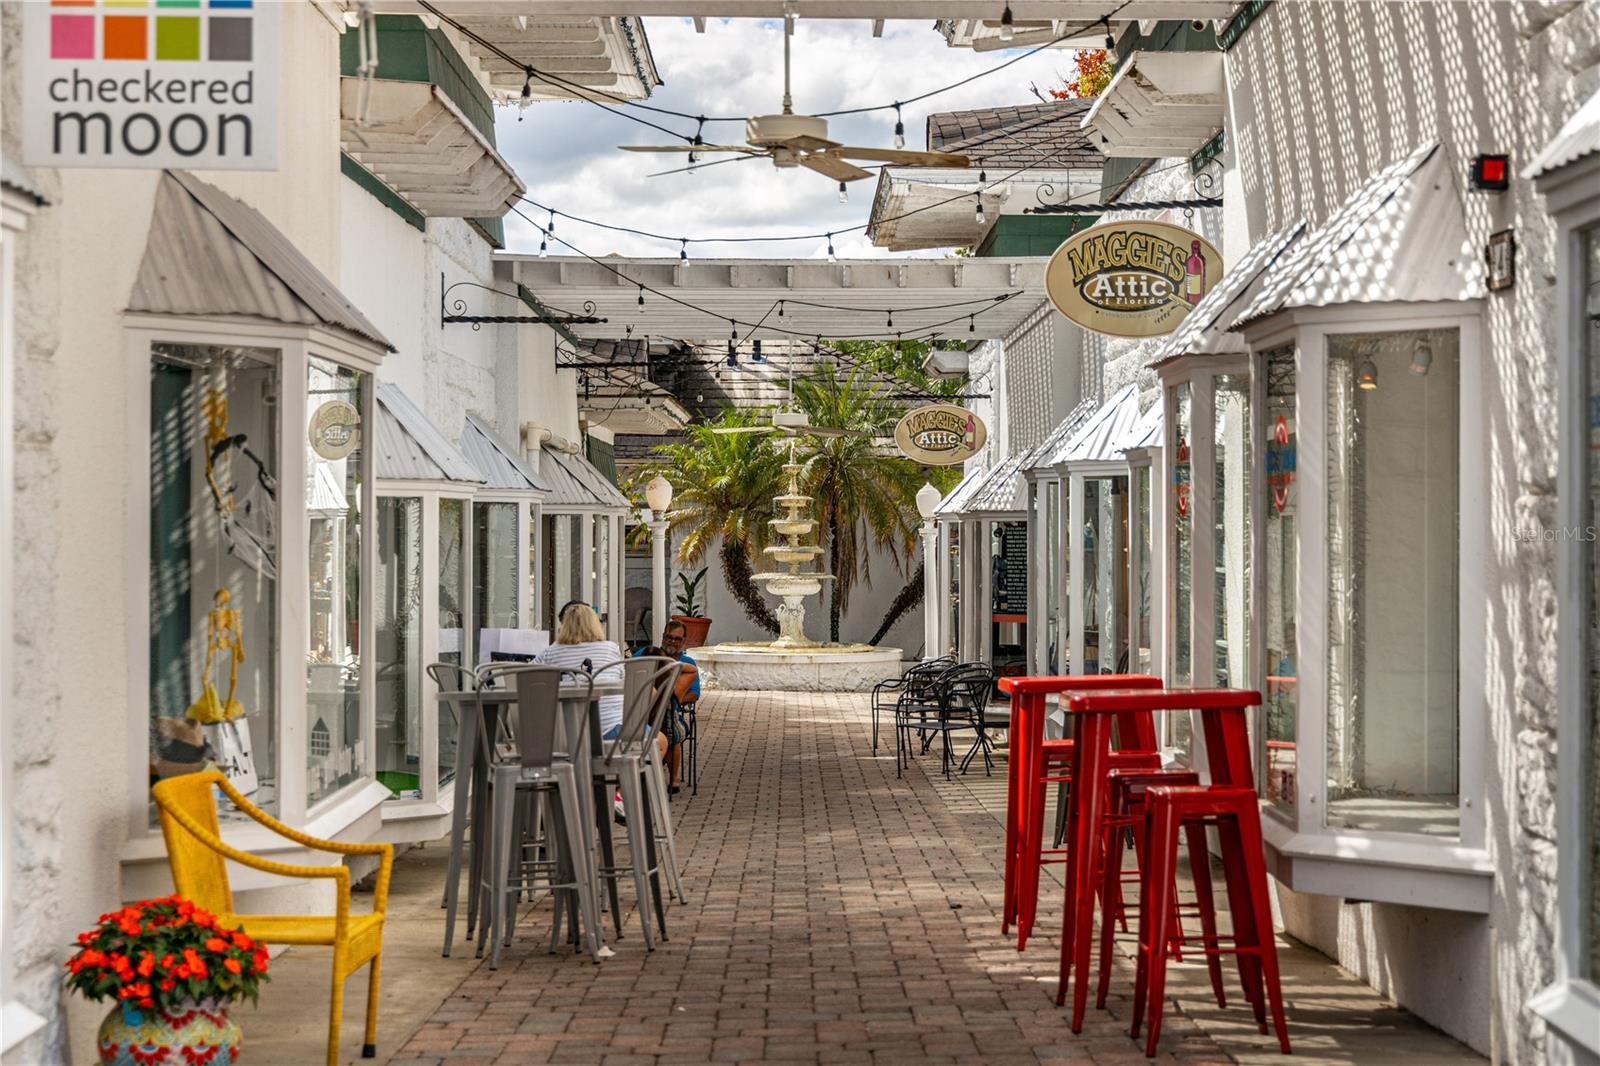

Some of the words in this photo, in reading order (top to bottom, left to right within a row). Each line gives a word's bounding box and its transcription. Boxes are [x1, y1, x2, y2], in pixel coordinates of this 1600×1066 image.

[49, 68, 253, 104] checkered
[52, 110, 253, 156] moon
[1069, 231, 1187, 285] MAGGIE'S
[1092, 274, 1167, 297] Attic
[1097, 297, 1110, 305] of
[1116, 296, 1164, 305] Florida
[907, 411, 966, 437] MAGGIE'S
[919, 432, 957, 444] Attic
